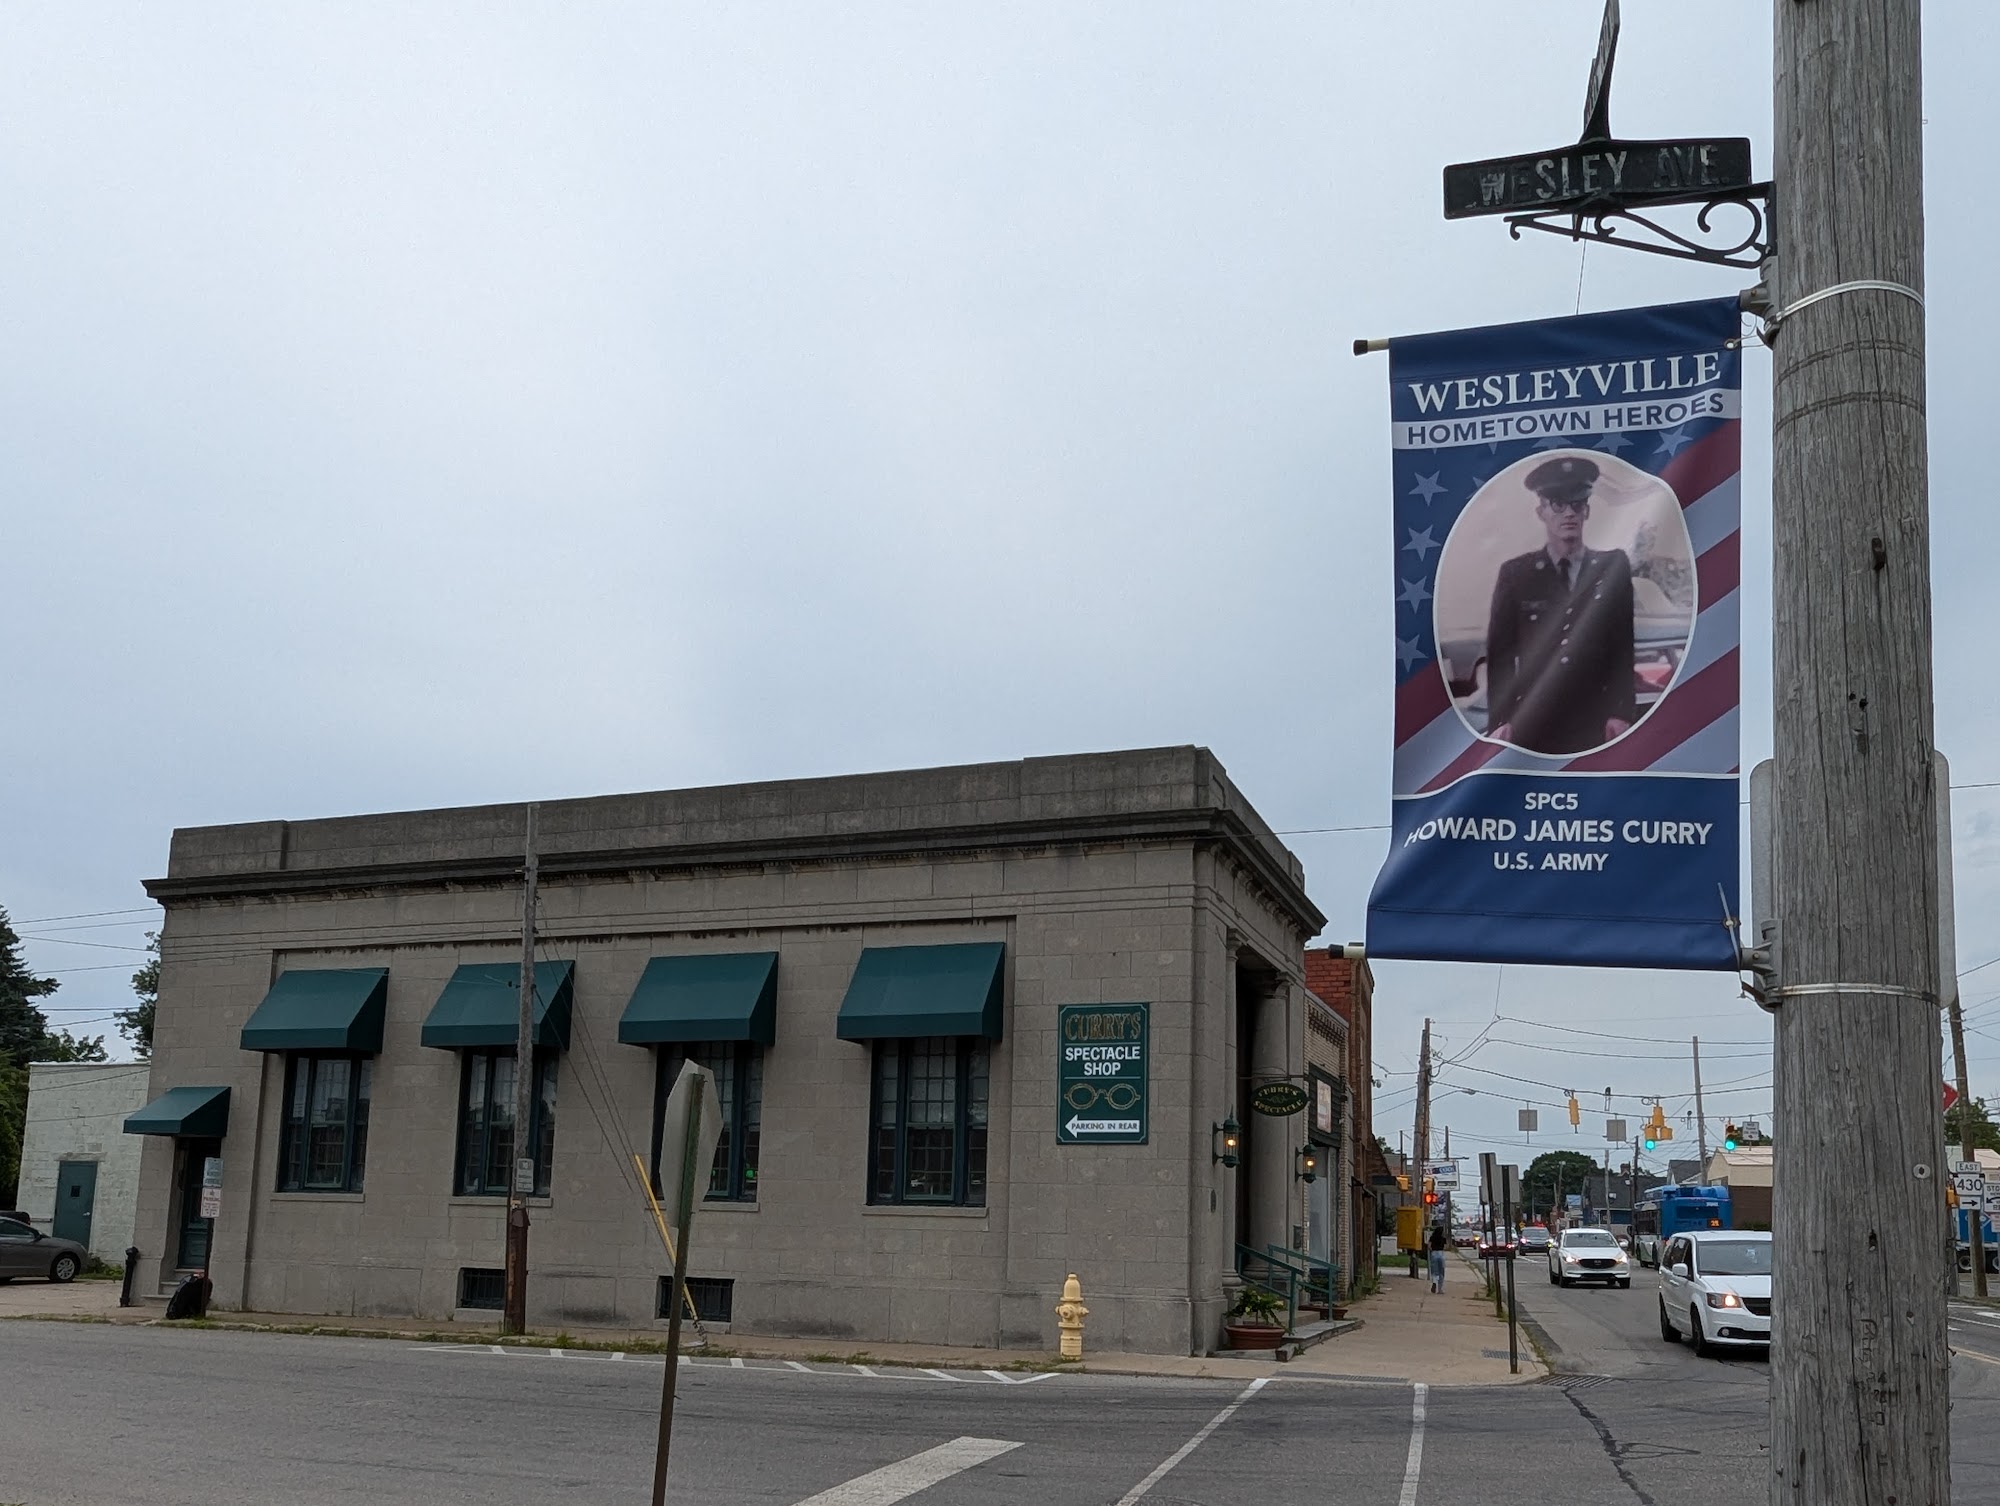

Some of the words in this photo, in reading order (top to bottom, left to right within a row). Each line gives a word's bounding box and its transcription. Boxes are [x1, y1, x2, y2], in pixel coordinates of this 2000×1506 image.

[1408, 351, 1722, 414] WESLEYVILLE
[1408, 410, 1591, 445] HOMETOWN
[1604, 392, 1724, 429] HEROES
[1524, 792, 1579, 811] SPC5
[1403, 817, 1517, 848] HOWARD
[1523, 819, 1614, 843] JAMES
[1622, 820, 1713, 845] CURRY
[1493, 852, 1534, 871] U.S.
[1540, 853, 1609, 872] ARMY
[1064, 1012, 1141, 1040] CURRY'S
[1064, 1046, 1141, 1061] SPECTACLE
[1083, 1062, 1121, 1076] SHOP
[1071, 1122, 1105, 1130] PARKING
[1118, 1122, 1138, 1130] REAR
[1959, 1163, 1978, 1171] EAST
[1956, 1178, 1983, 1192] 430
